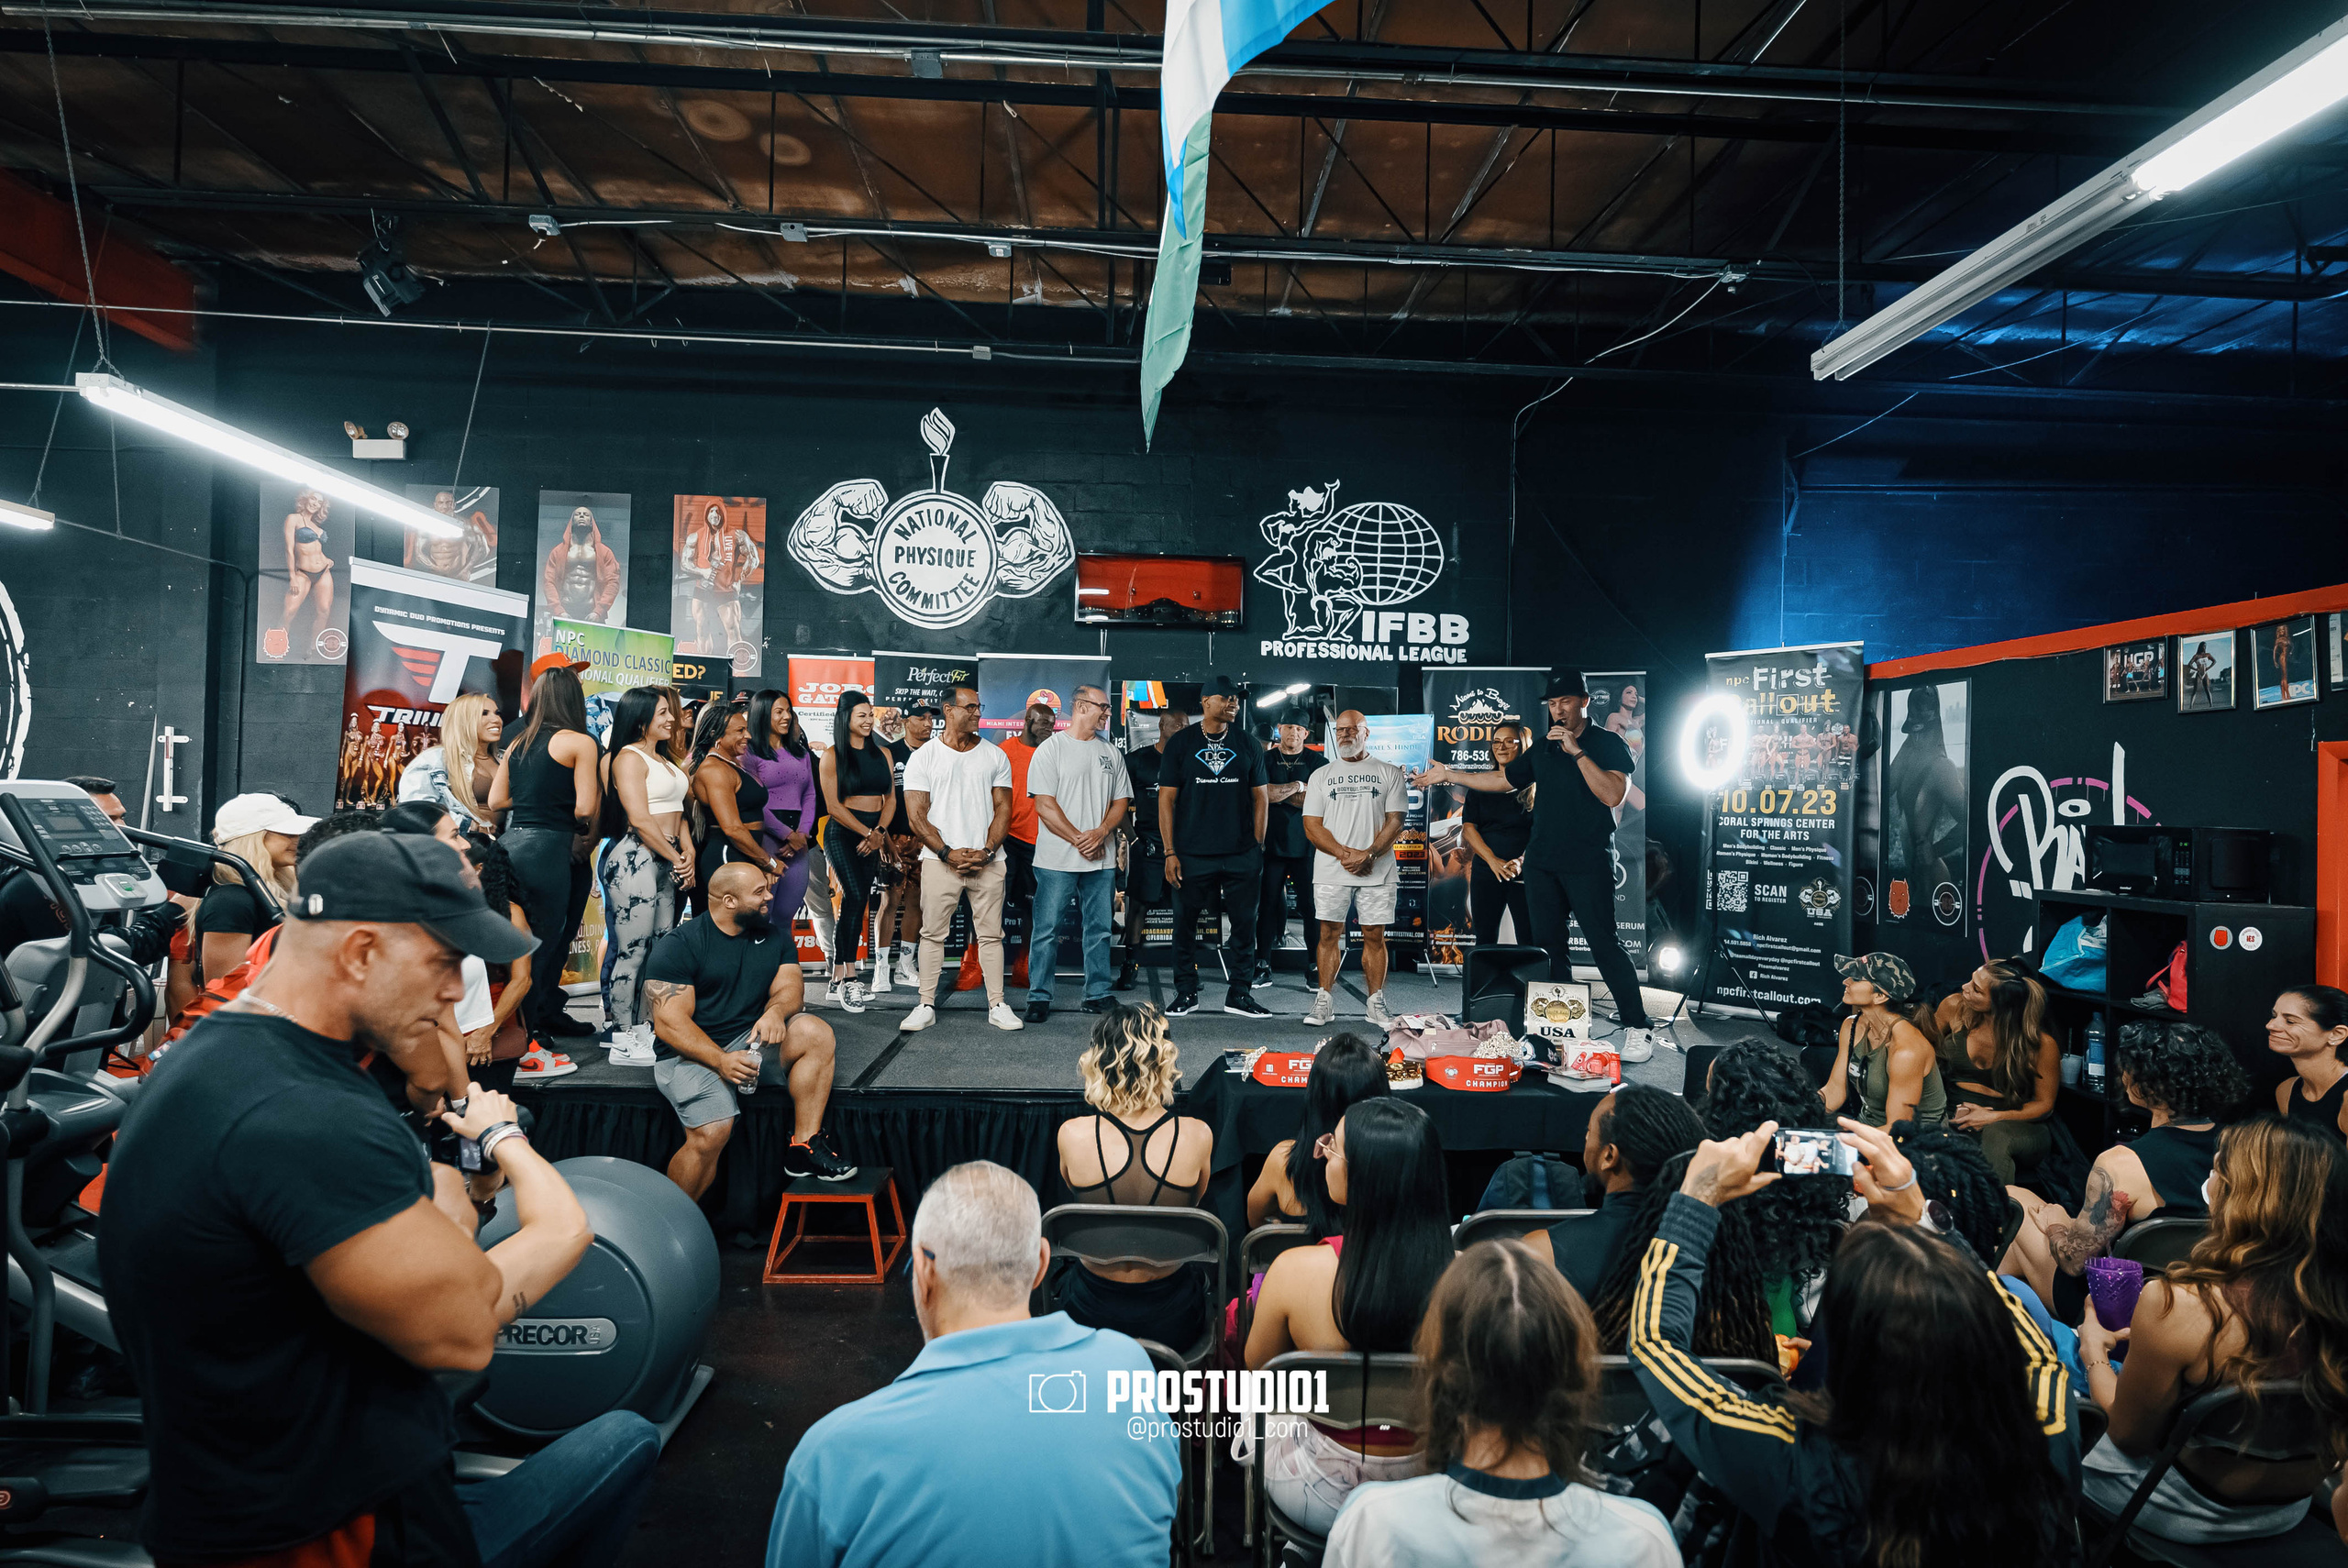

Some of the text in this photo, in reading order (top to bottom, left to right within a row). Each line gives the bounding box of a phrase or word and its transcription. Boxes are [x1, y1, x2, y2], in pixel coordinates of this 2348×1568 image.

[893, 509, 977, 545] NATIONAL
[725, 536, 733, 553] LIVE
[894, 546, 976, 569] PHYSIQUE
[888, 571, 980, 609] COMMITTEE
[374, 606, 505, 635] DYNAMIC DUO PROMOTIONS PRESENTS
[1361, 611, 1469, 644] IFBB
[556, 629, 585, 646] NPC
[555, 645, 670, 674] DIAMOND CLASSIC
[1260, 641, 1468, 664] PROFESSIONAL LEAGUE
[581, 668, 613, 684] IONAL
[672, 663, 706, 680] ED?
[1725, 662, 1832, 691] npc First
[1450, 690, 1476, 711] Miami
[367, 705, 443, 727] TRIU
[1327, 775, 1382, 786] OLD SCHOOL
[1719, 790, 1837, 815] 10.07.23
[1751, 817, 1793, 828] SPRINGS
[1796, 818, 1835, 829] CENTER
[1740, 829, 1810, 841] FOR THE ARTS
[1781, 853, 1811, 861] Bodybuilding
[1755, 884, 1788, 898] SCAN
[1616, 922, 1645, 930] SERUM
[1766, 935, 1788, 944] Alvarez
[1539, 1027, 1577, 1038] USA
[1288, 1059, 1313, 1070] FG
[1473, 1064, 1504, 1075] FGP
[1280, 1076, 1308, 1084] CHAM
